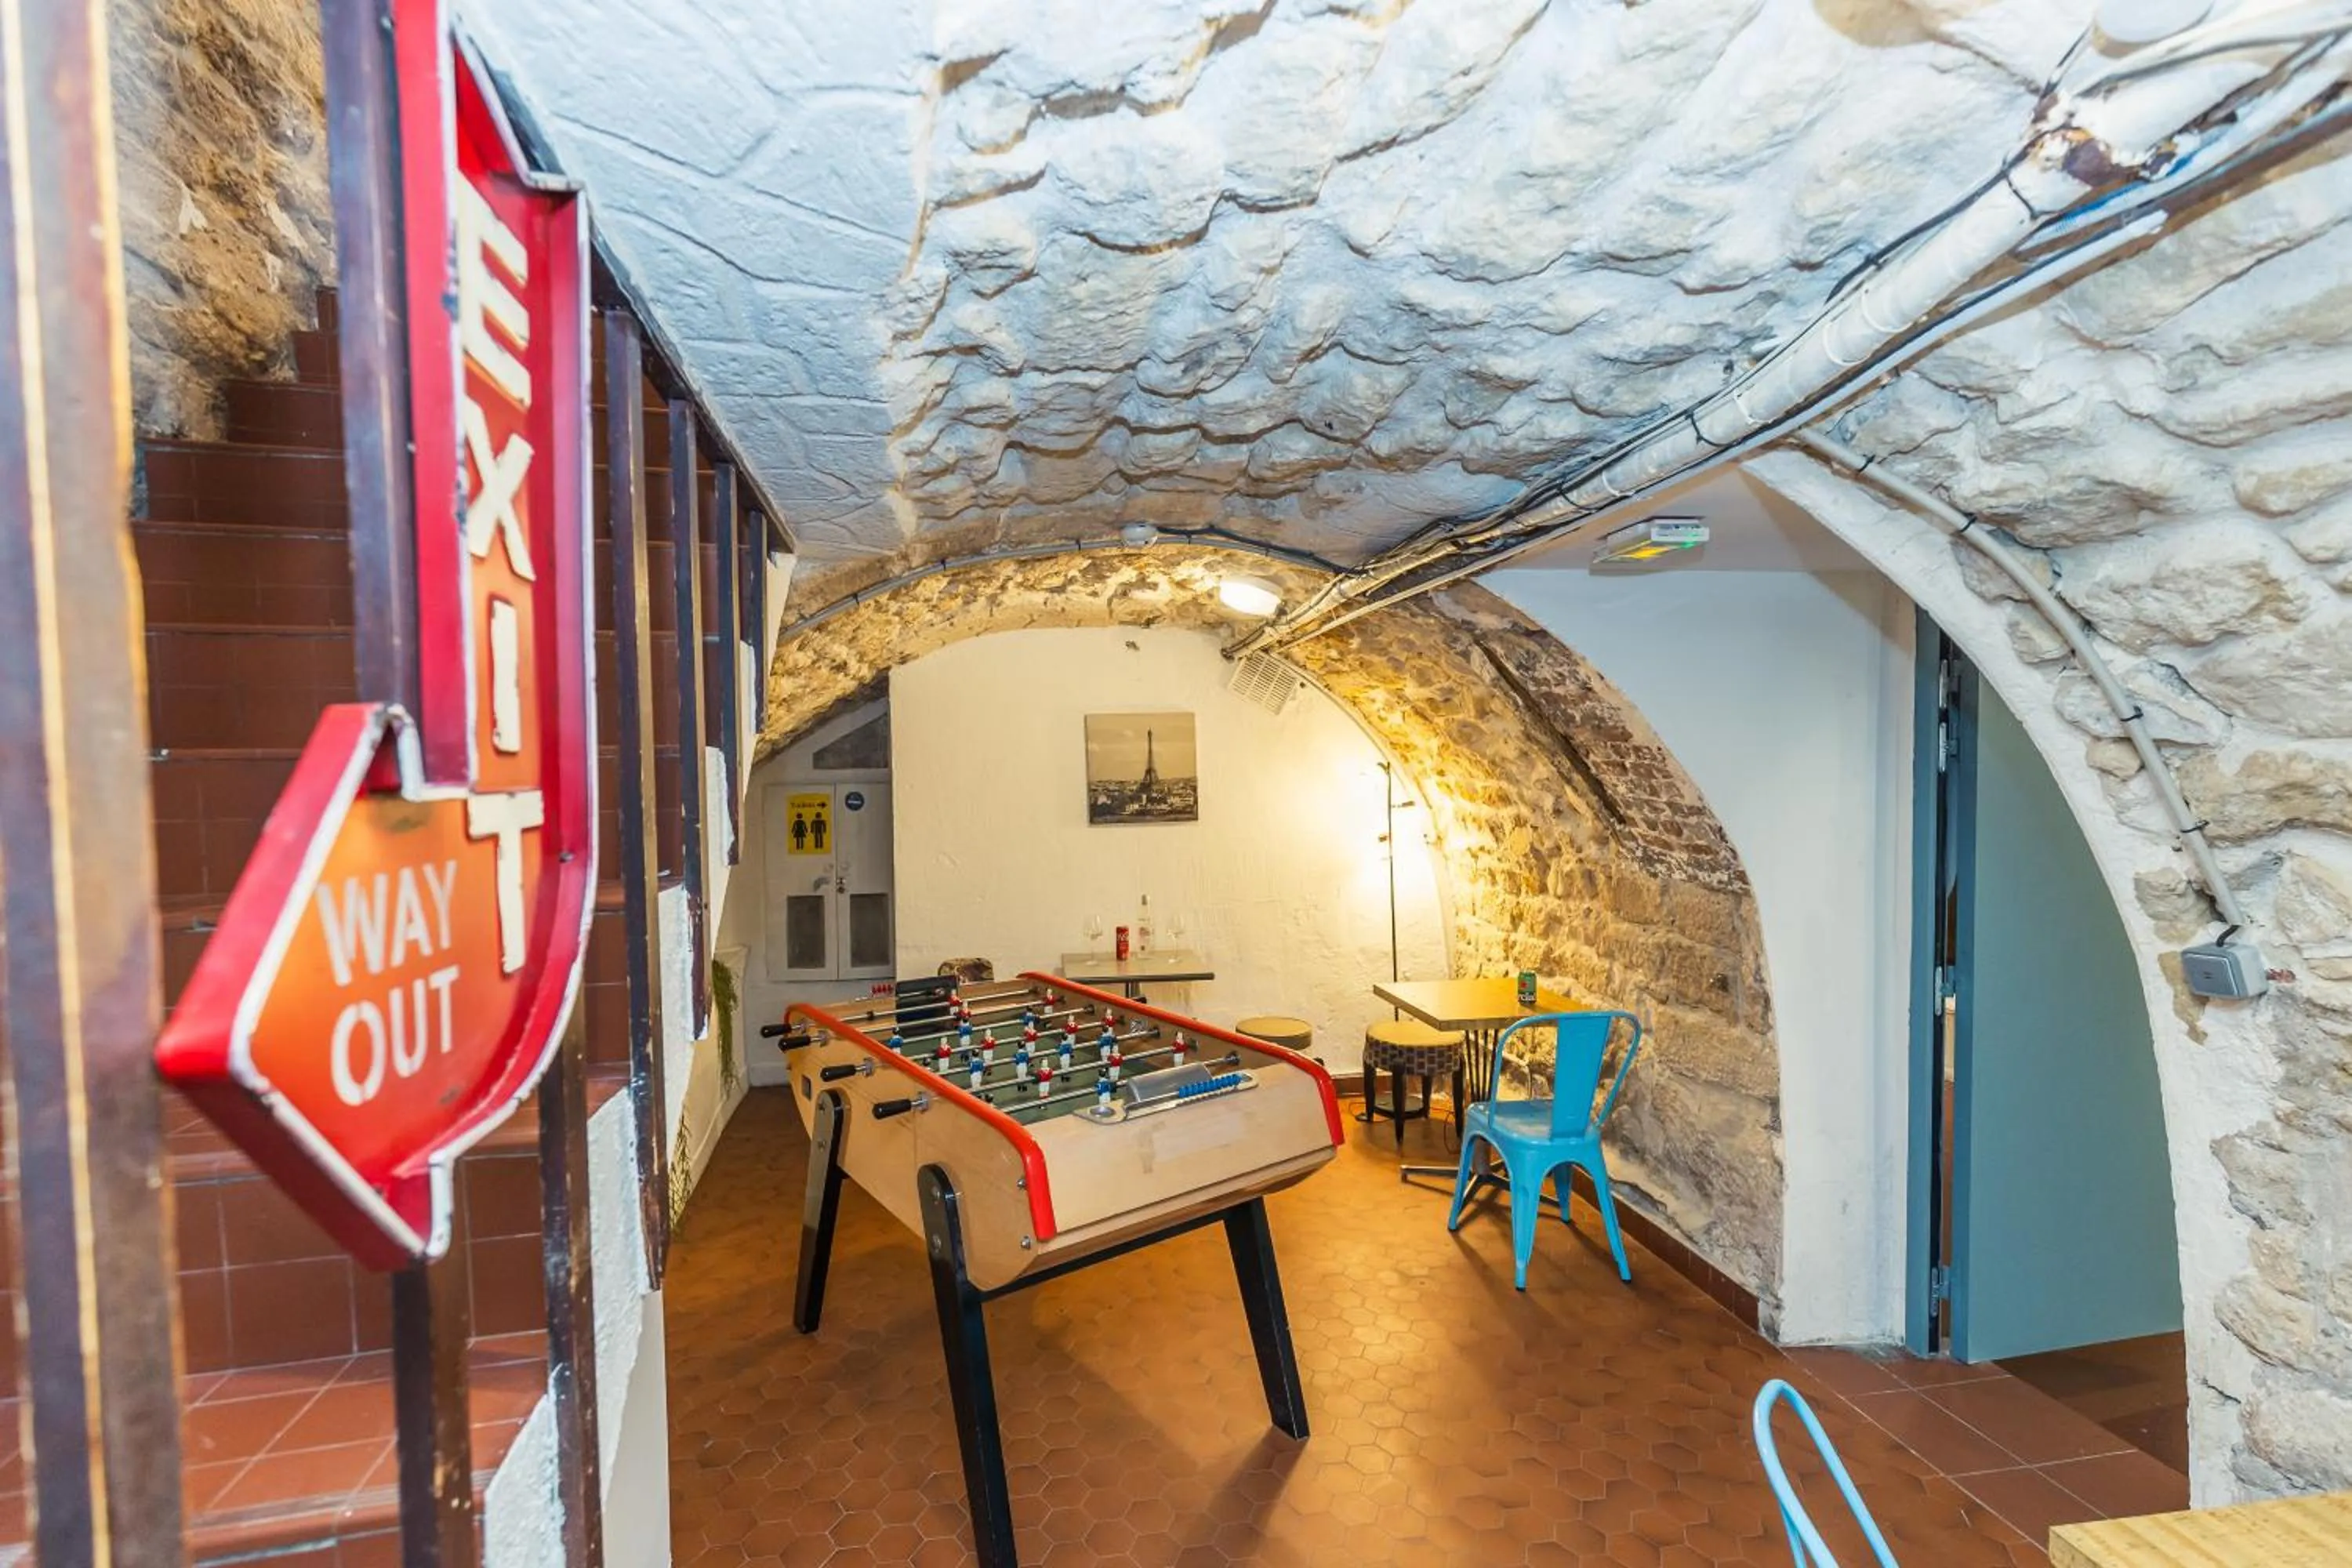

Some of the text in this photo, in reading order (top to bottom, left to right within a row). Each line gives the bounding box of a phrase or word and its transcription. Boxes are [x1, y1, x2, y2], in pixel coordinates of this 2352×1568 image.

[456, 167, 544, 974] EXIT
[316, 859, 458, 987] WAY
[330, 964, 461, 1106] OUT
